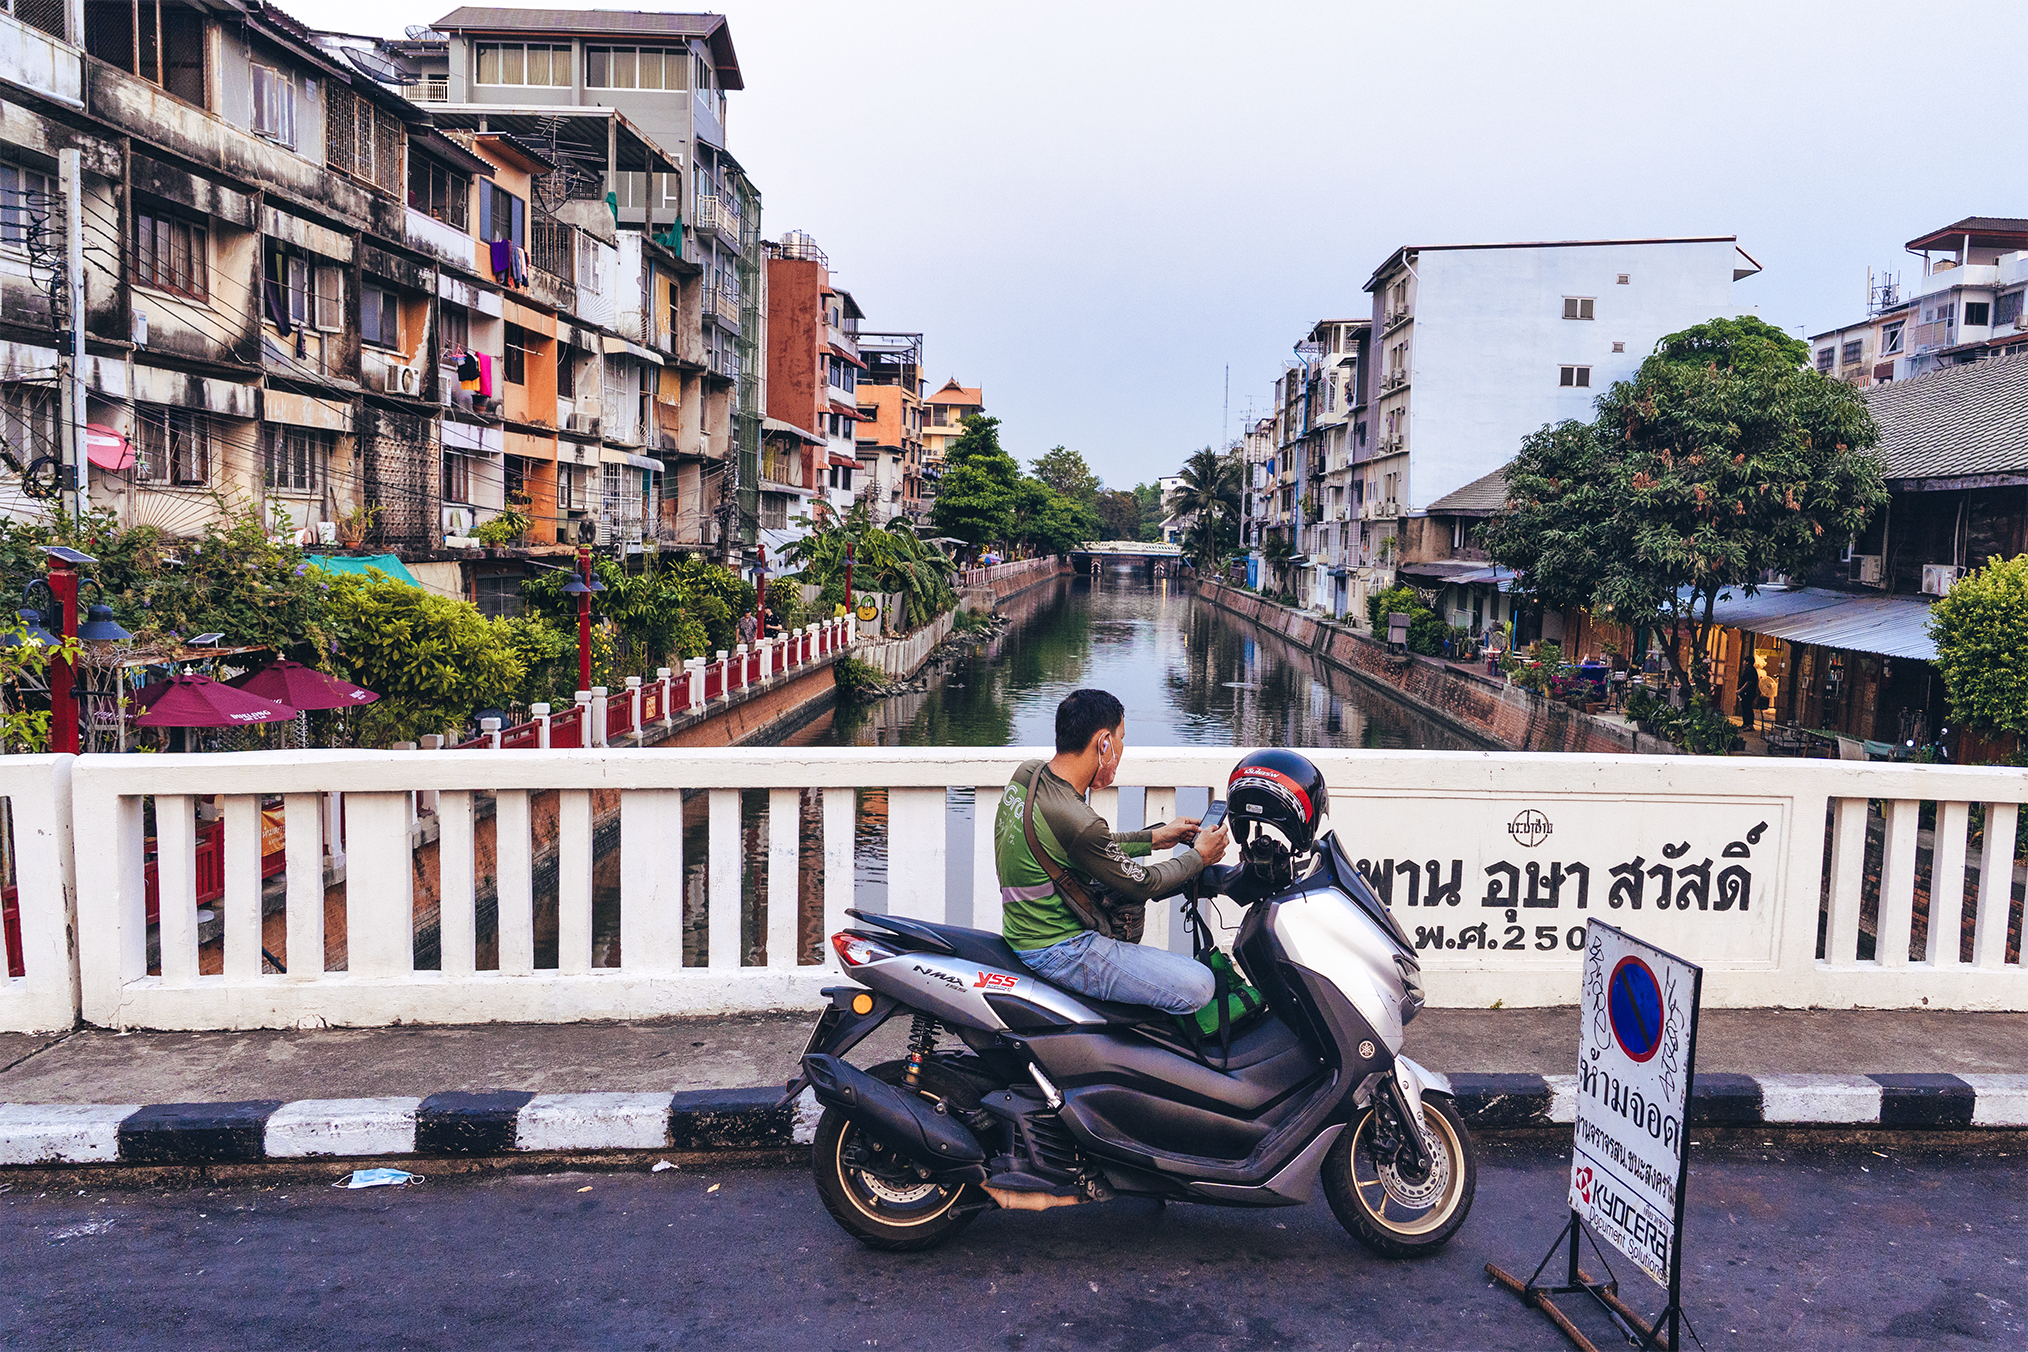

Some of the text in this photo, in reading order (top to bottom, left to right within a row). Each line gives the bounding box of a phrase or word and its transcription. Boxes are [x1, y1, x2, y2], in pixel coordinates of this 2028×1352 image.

[1003, 785, 1025, 823] Gra
[1105, 841, 1146, 882] Grab
[1481, 860, 1590, 923] อุษา
[1609, 821, 1769, 911] สวัสดิ์
[1415, 922, 1621, 950] พ.ศ.250
[912, 965, 964, 987] NMAX
[973, 971, 1019, 988] YSS
[1580, 1048, 1680, 1159] ห้ามจอด
[1589, 1205, 1626, 1249] Document
[1592, 1178, 1667, 1272] KYOCERA
